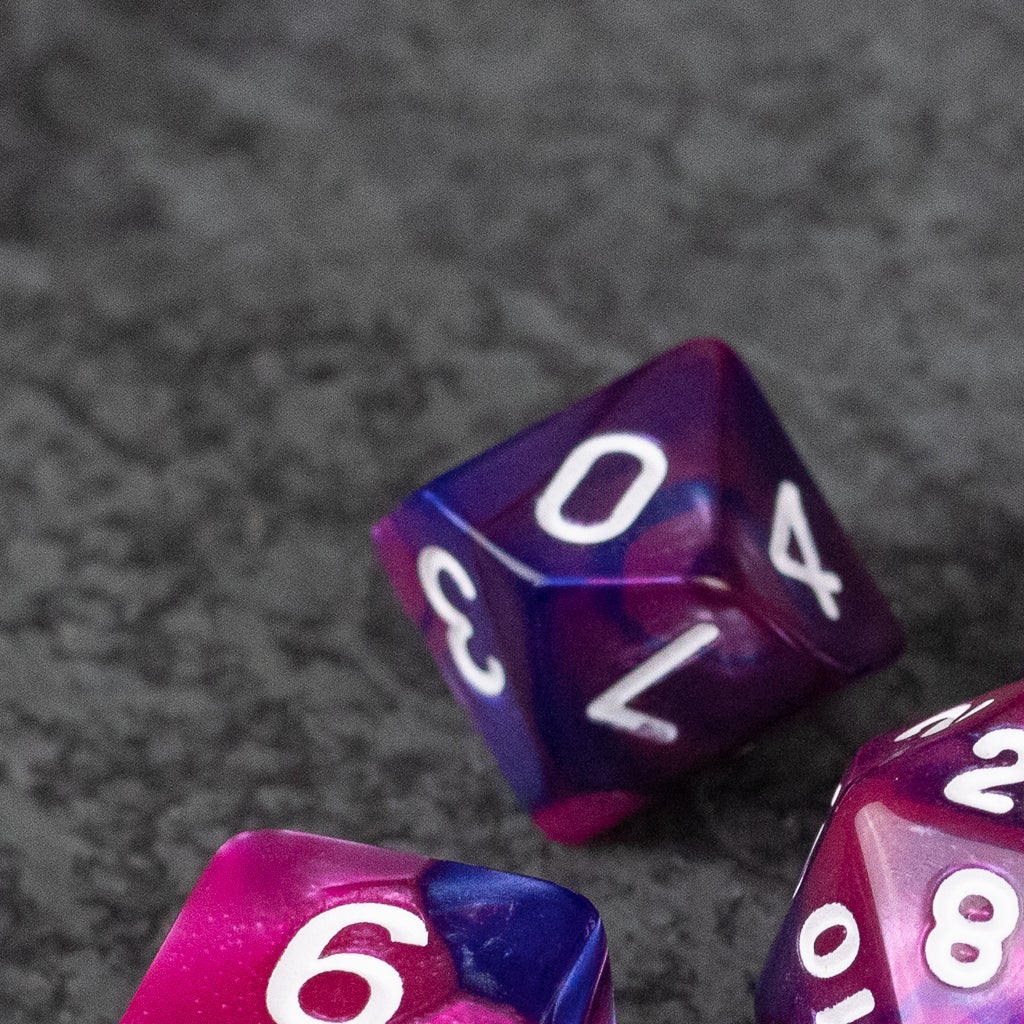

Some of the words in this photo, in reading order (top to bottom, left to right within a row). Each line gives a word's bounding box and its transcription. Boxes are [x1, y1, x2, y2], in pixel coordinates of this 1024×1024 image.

[534, 432, 668, 545] 0
[768, 480, 842, 621] 4
[416, 545, 506, 698] 3
[586, 622, 720, 743] 7
